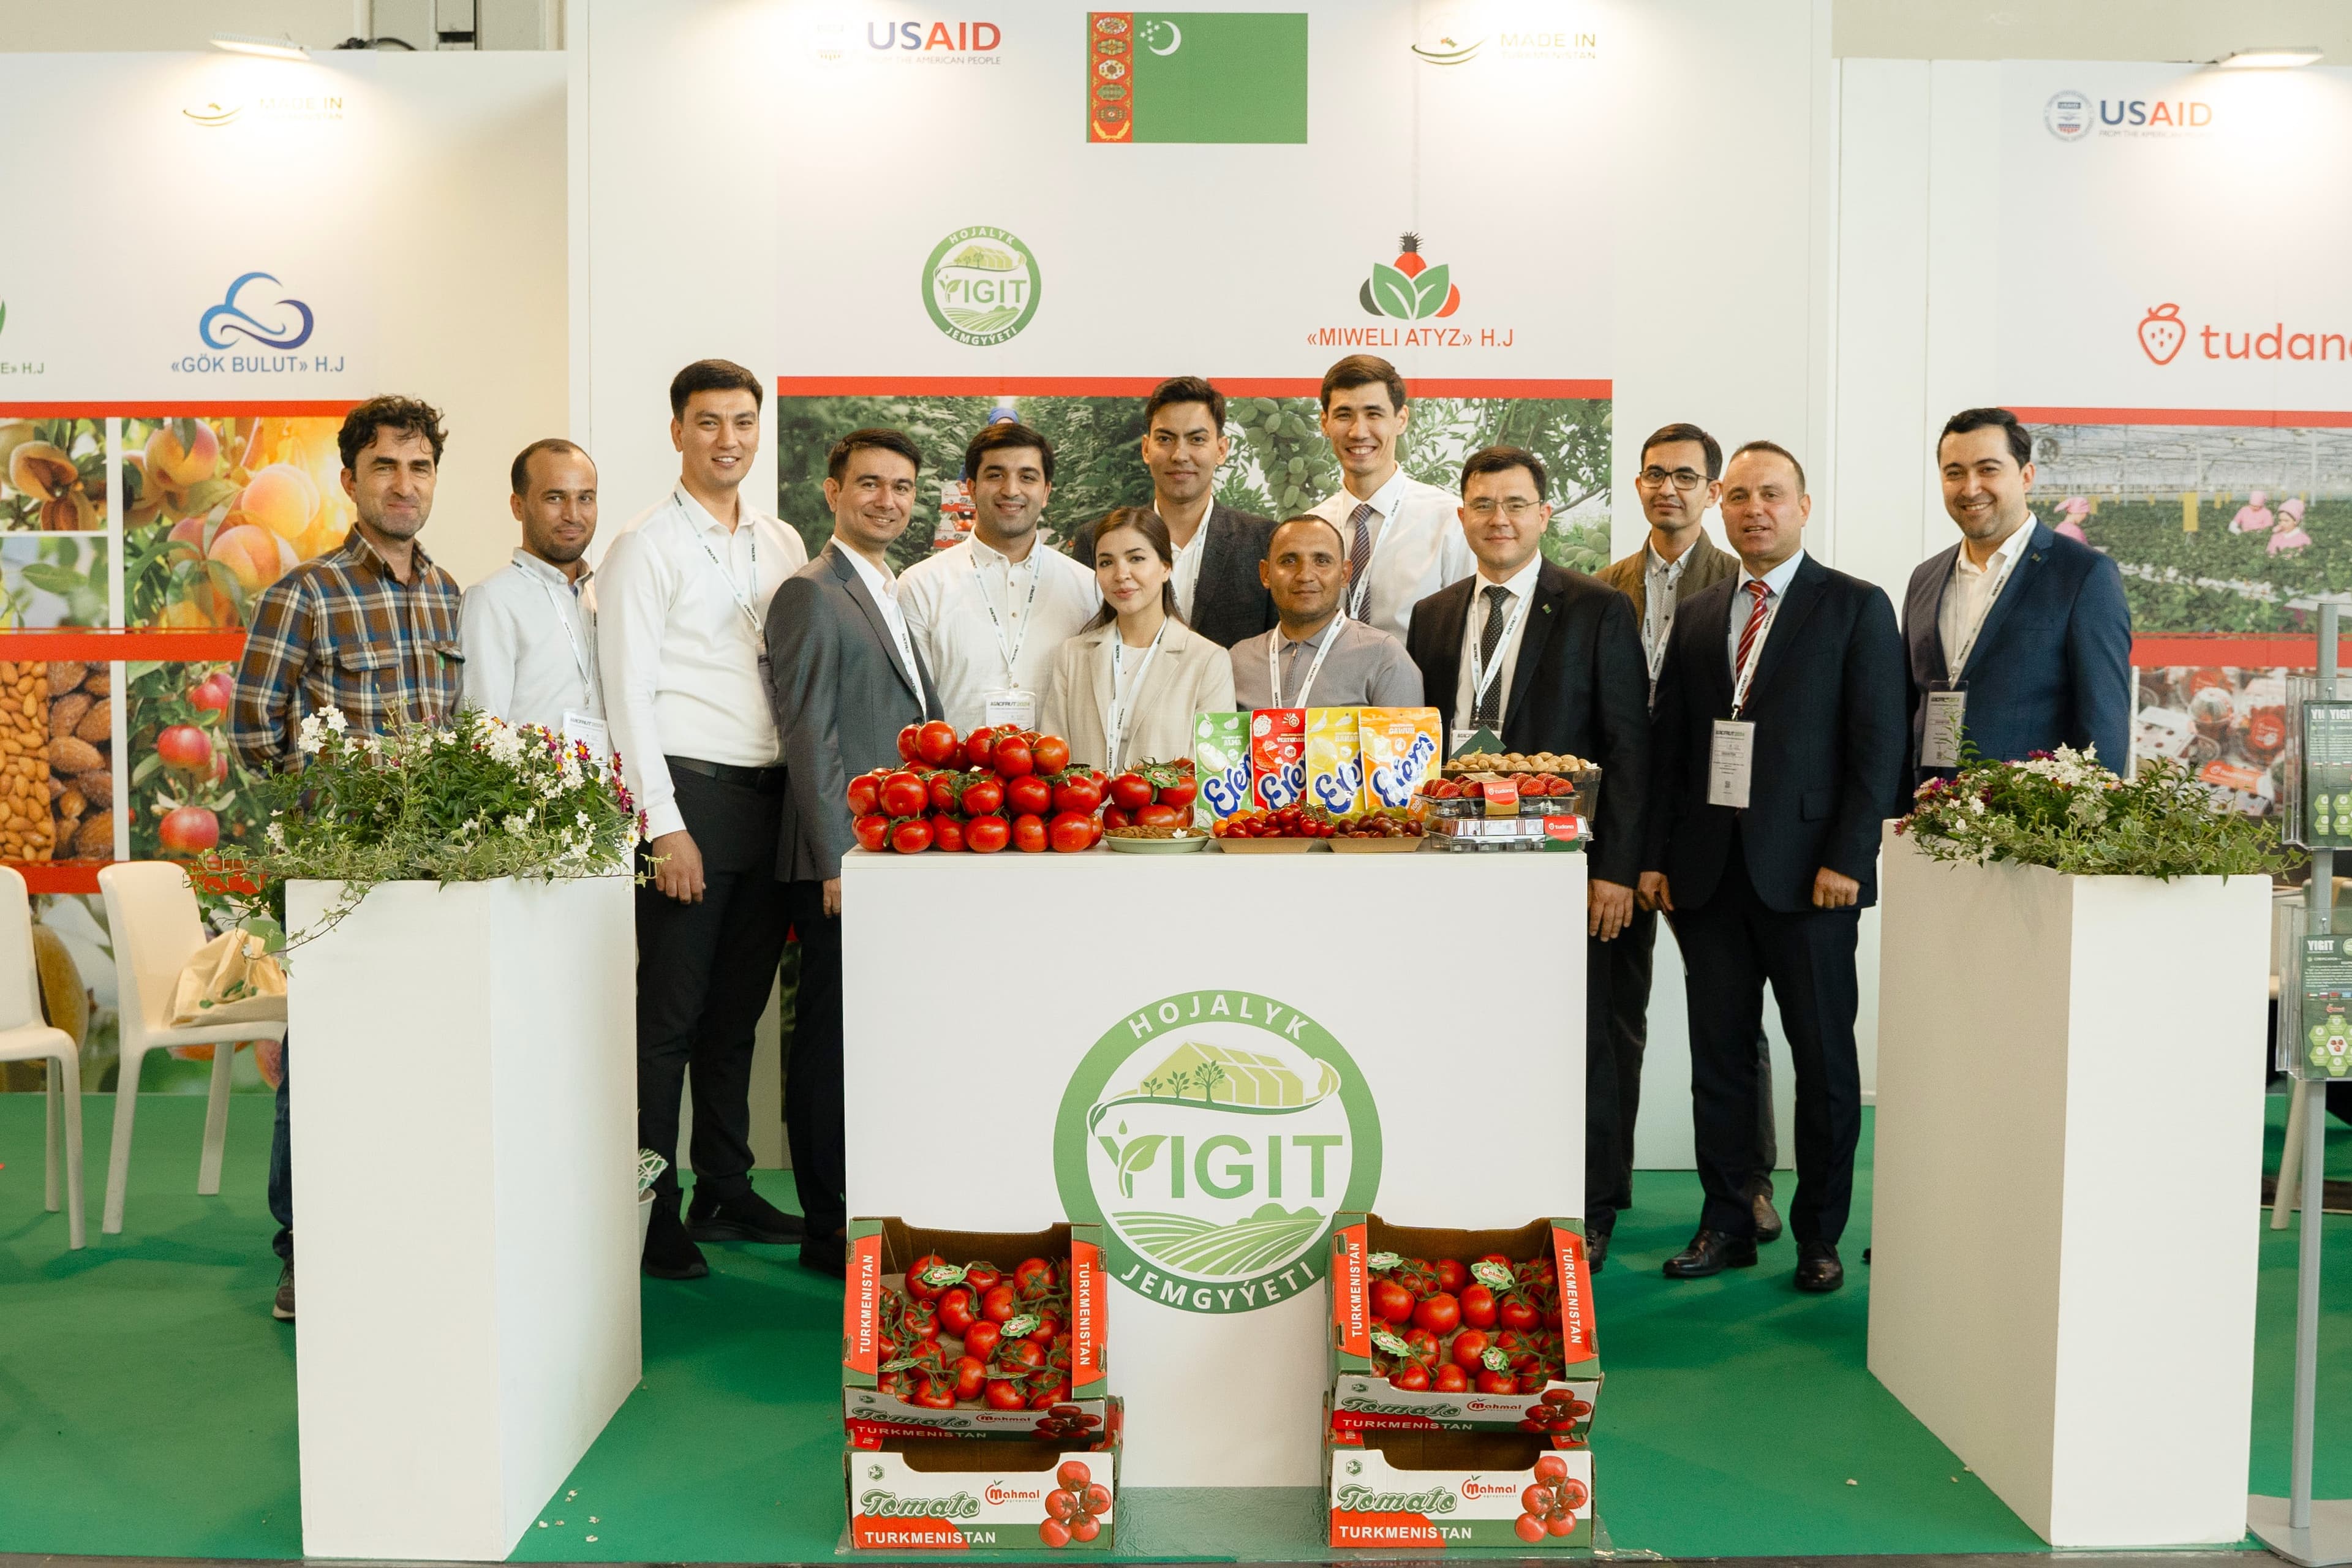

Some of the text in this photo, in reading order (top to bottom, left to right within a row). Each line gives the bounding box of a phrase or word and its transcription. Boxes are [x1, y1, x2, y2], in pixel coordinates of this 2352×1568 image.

[867, 21, 1001, 51] USAID
[1501, 34, 1596, 47] MADE IN
[916, 56, 965, 65] AMERICAN
[968, 56, 1001, 66] PEOPLE
[323, 97, 343, 109] IN
[2100, 100, 2212, 126] USAID
[949, 227, 1016, 244] HOJALYK
[938, 279, 1027, 303] YIGIT
[1307, 328, 1513, 347] «MIWELI ATYZ» H.J
[2200, 323, 2352, 361] tudan
[23, 363, 44, 374] H.J
[172, 353, 344, 372] «GÖK BULUT» H.J
[2307, 940, 2334, 951] YIGIT
[1128, 995, 1310, 1040] HOJALYK
[1097, 1134, 1343, 1199] YIGIT
[1121, 1261, 1316, 1310] JEMGYÝETI
[1349, 1243, 1363, 1337] TURKMENISTAN
[859, 1254, 873, 1354] TURKMENISTAN
[1562, 1247, 1582, 1344] TURKMENISTAN
[1079, 1262, 1091, 1366] TURKMENISTAN
[1341, 1396, 1461, 1417] Tomato
[1468, 1400, 1521, 1411] Mahmal
[852, 1407, 971, 1427] Tomato
[978, 1414, 1031, 1424] Mahmal
[1343, 1419, 1472, 1430] TURKMENISTAN
[857, 1426, 987, 1439] TURKMENISTAN
[987, 1487, 1040, 1501] Mahmal
[1337, 1483, 1458, 1513] Tomato
[1463, 1482, 1517, 1496] Mahmal
[861, 1488, 981, 1518] Tomato
[864, 1532, 996, 1544] TURKMENISTAN
[1339, 1526, 1472, 1539] TURKMENISTAN
